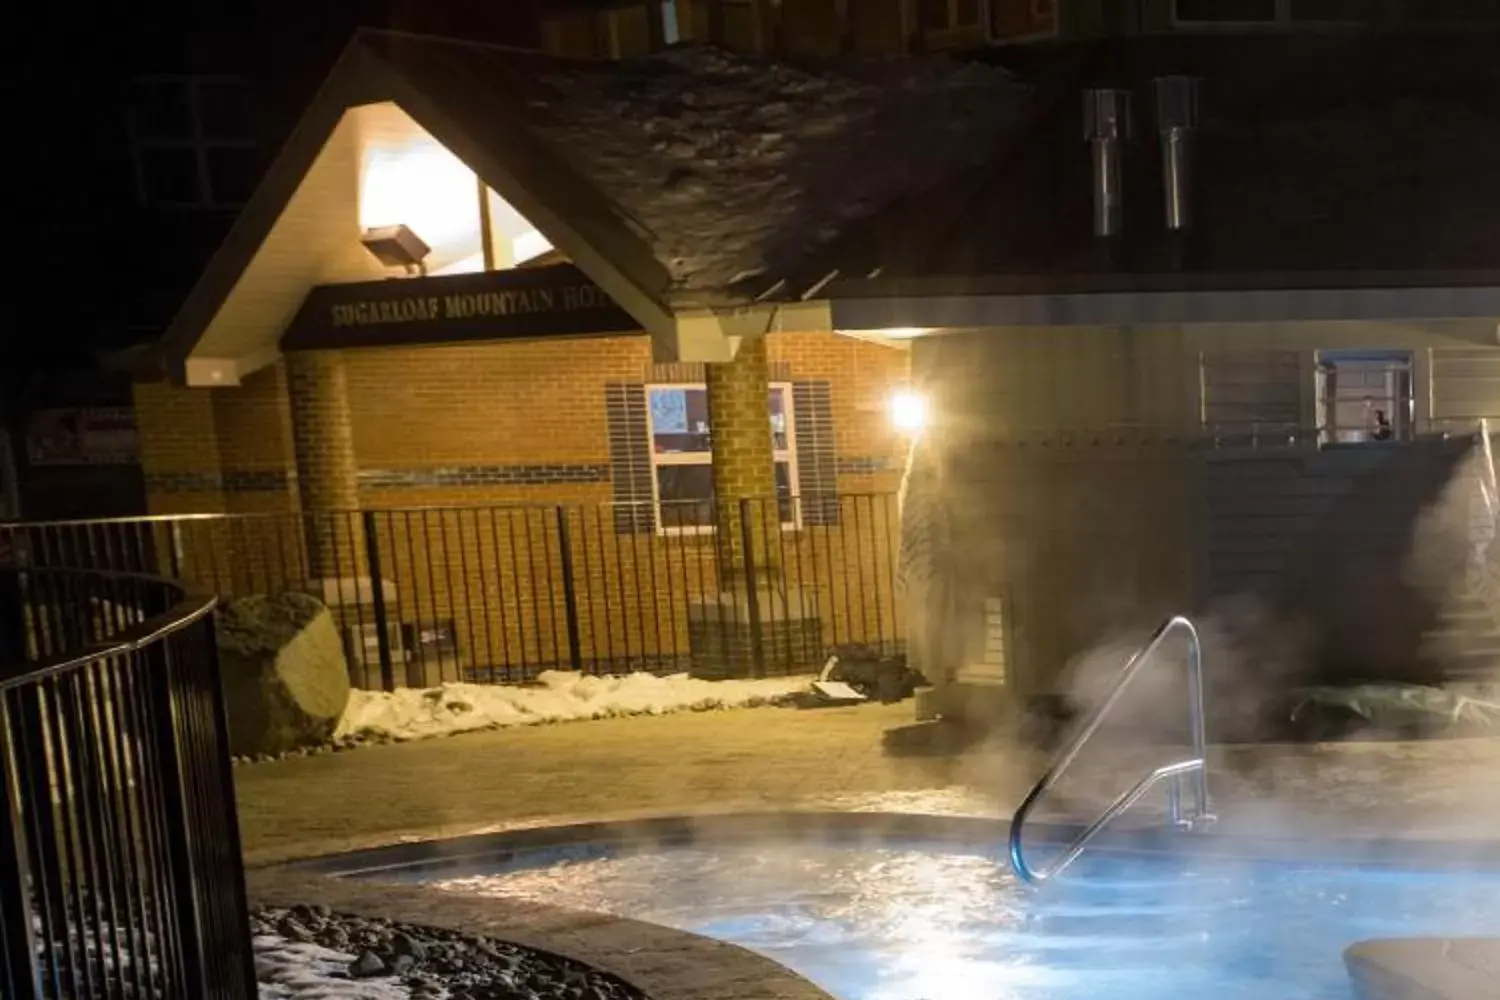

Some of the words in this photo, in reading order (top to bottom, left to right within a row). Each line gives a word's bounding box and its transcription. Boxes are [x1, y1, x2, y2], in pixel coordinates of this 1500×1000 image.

[331, 296, 438, 327] SUGARLOAF
[444, 288, 554, 319] MOUNTAIN
[563, 284, 606, 310] HOT
